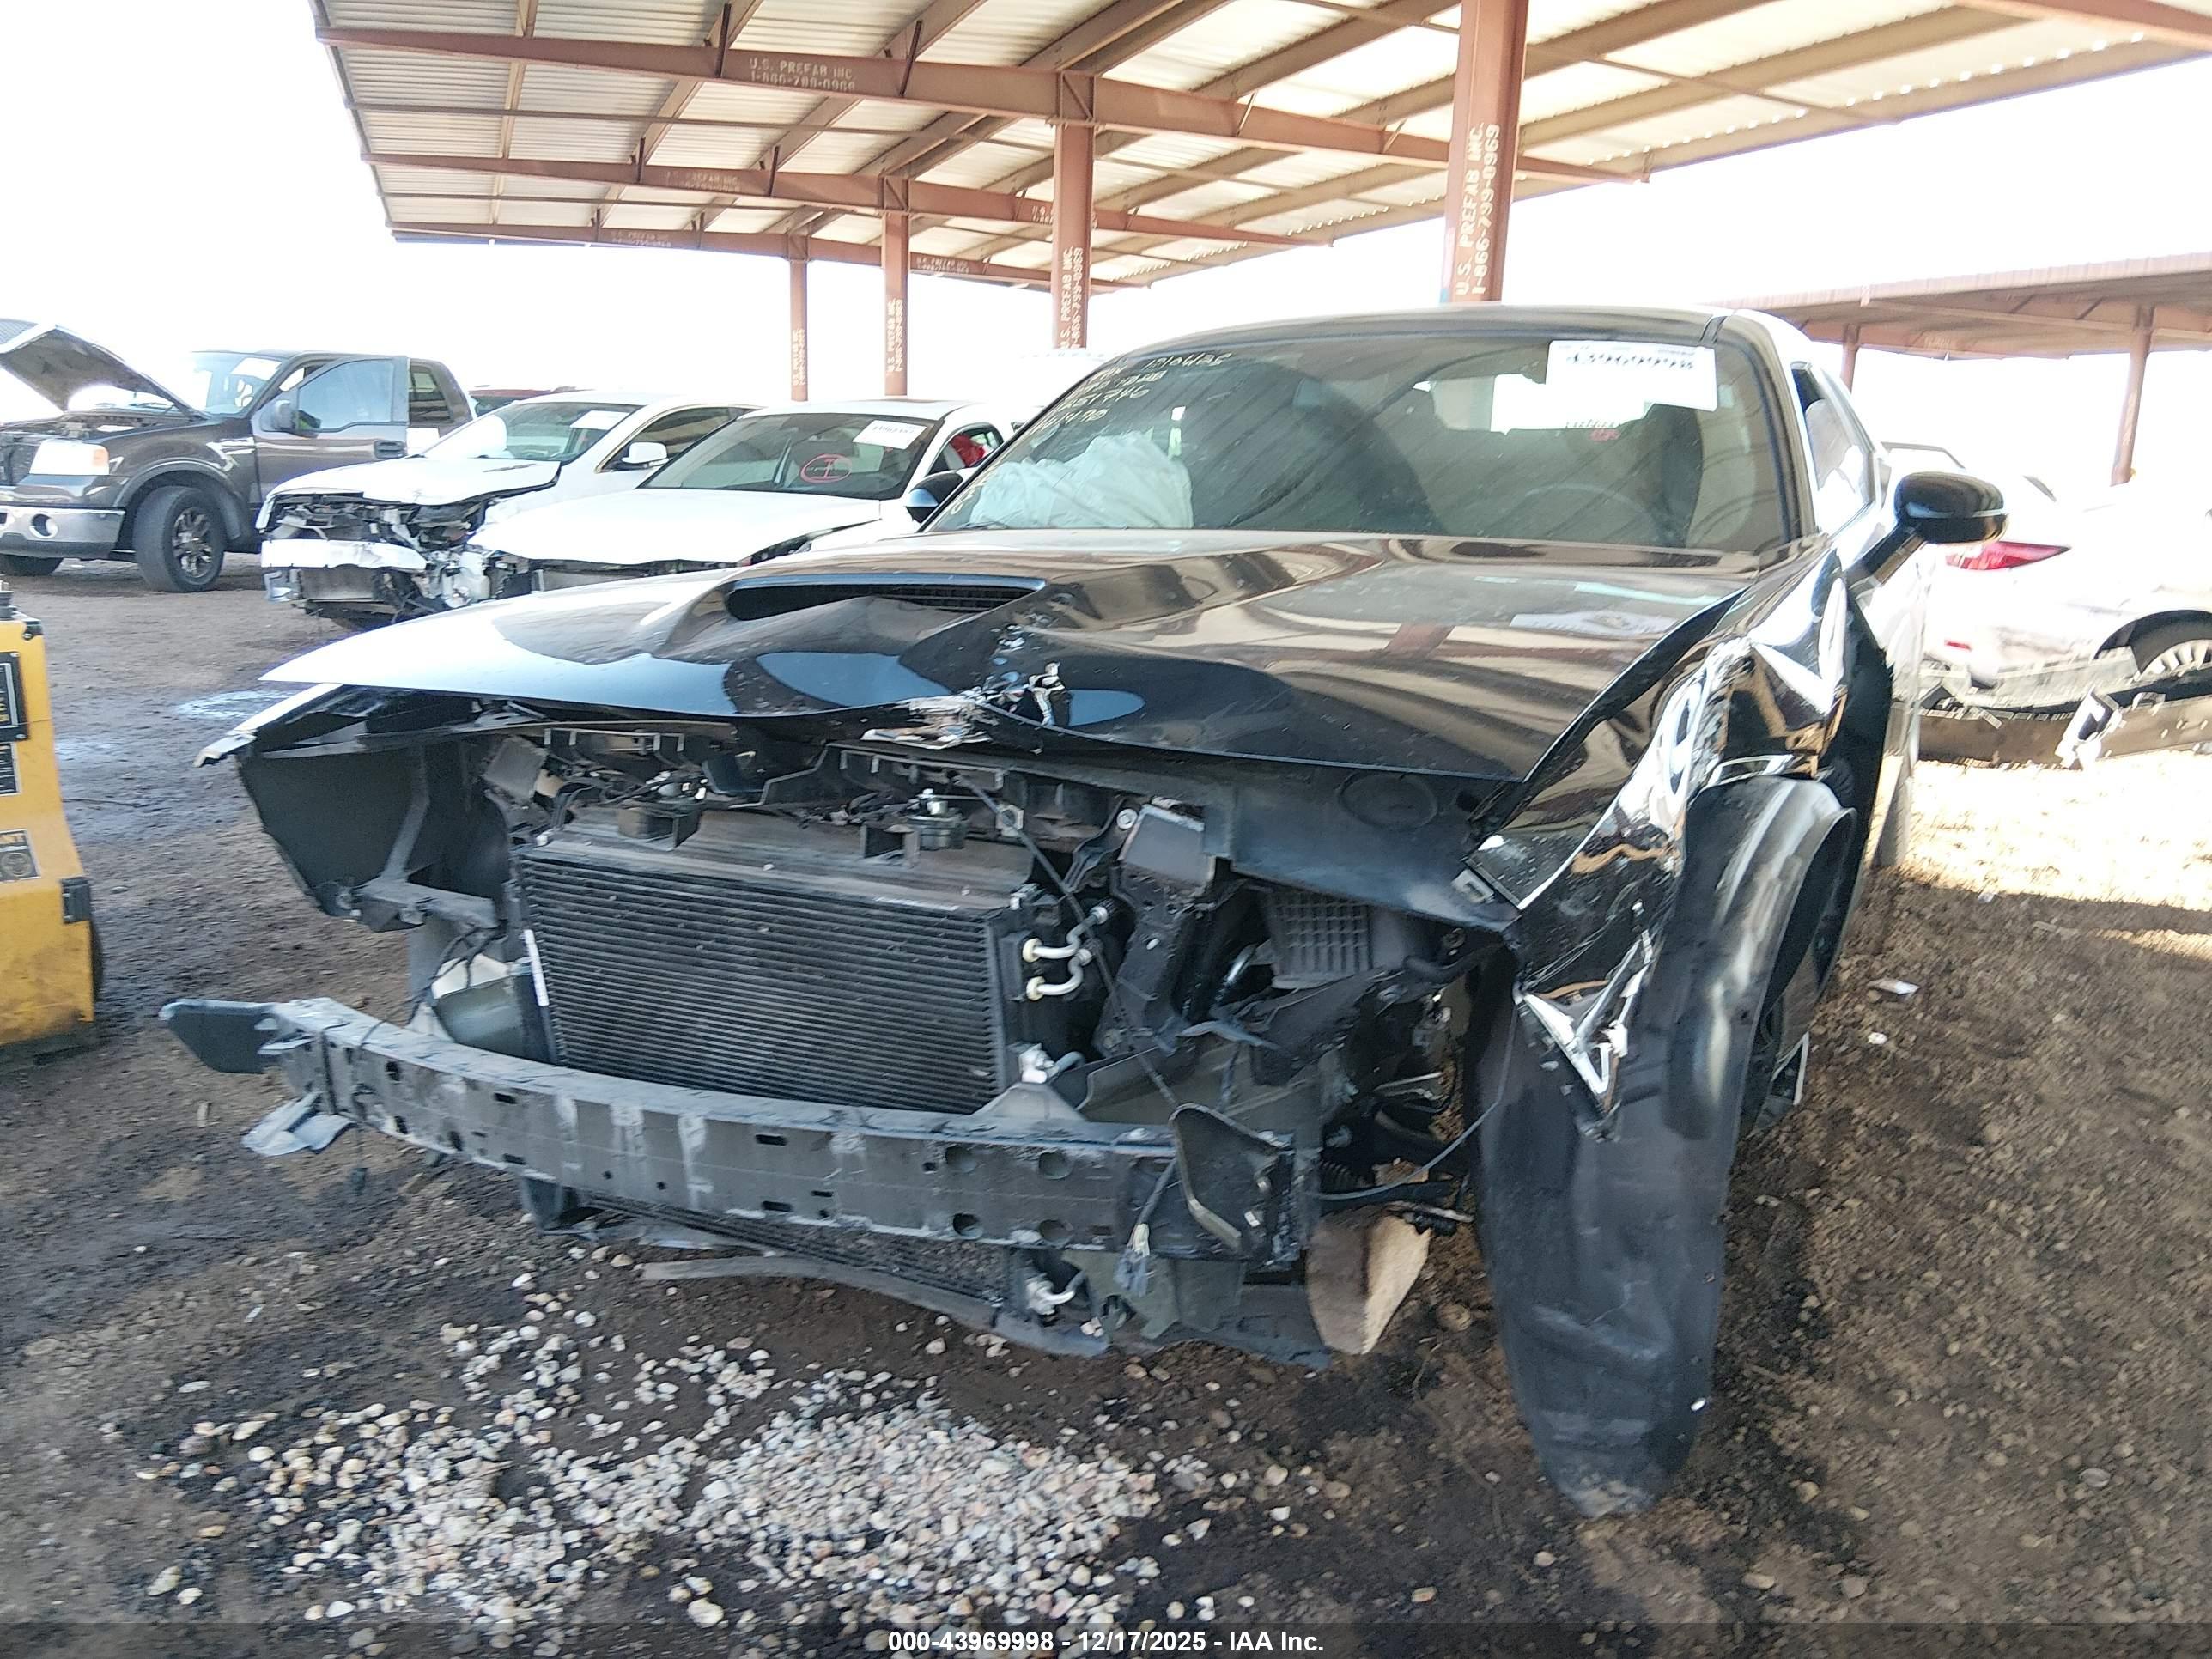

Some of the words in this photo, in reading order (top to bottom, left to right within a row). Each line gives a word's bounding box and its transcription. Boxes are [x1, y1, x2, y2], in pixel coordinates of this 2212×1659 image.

[780, 60, 828, 76] PREFAB
[1459, 169, 1480, 248] PREFAB
[1472, 124, 1499, 293] 1-866-799-0969
[1455, 256, 1473, 295] U.S.
